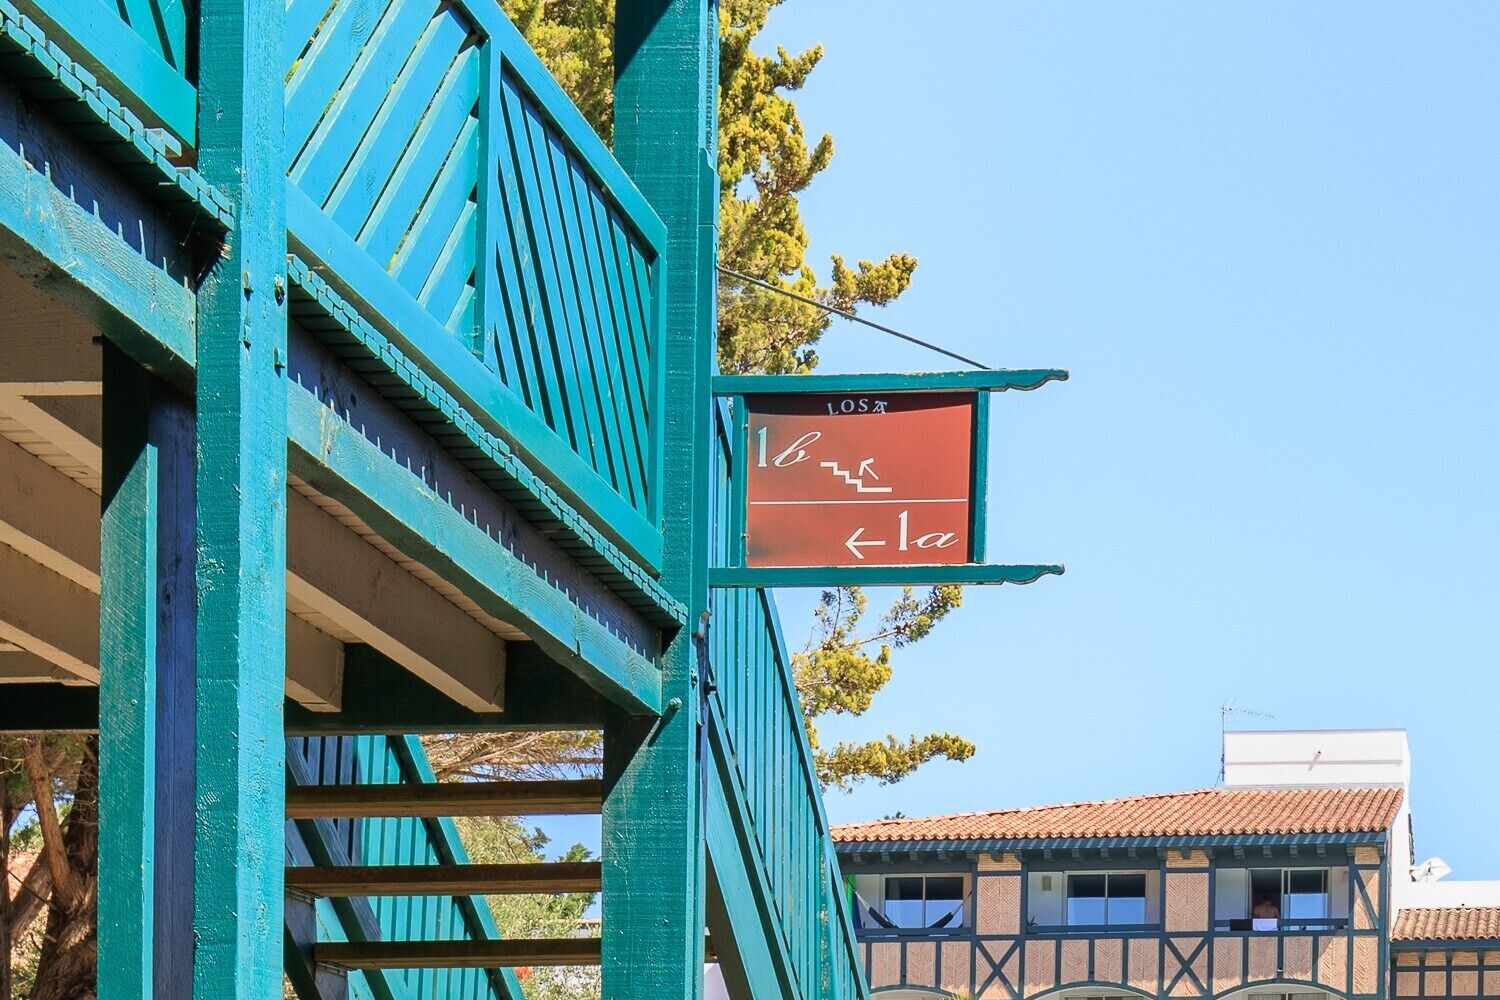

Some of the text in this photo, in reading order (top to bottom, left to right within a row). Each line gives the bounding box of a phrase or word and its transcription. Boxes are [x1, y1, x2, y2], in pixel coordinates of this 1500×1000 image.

[826, 398, 888, 416] LOSA
[757, 427, 822, 468] 1b
[898, 510, 960, 552] 1a
